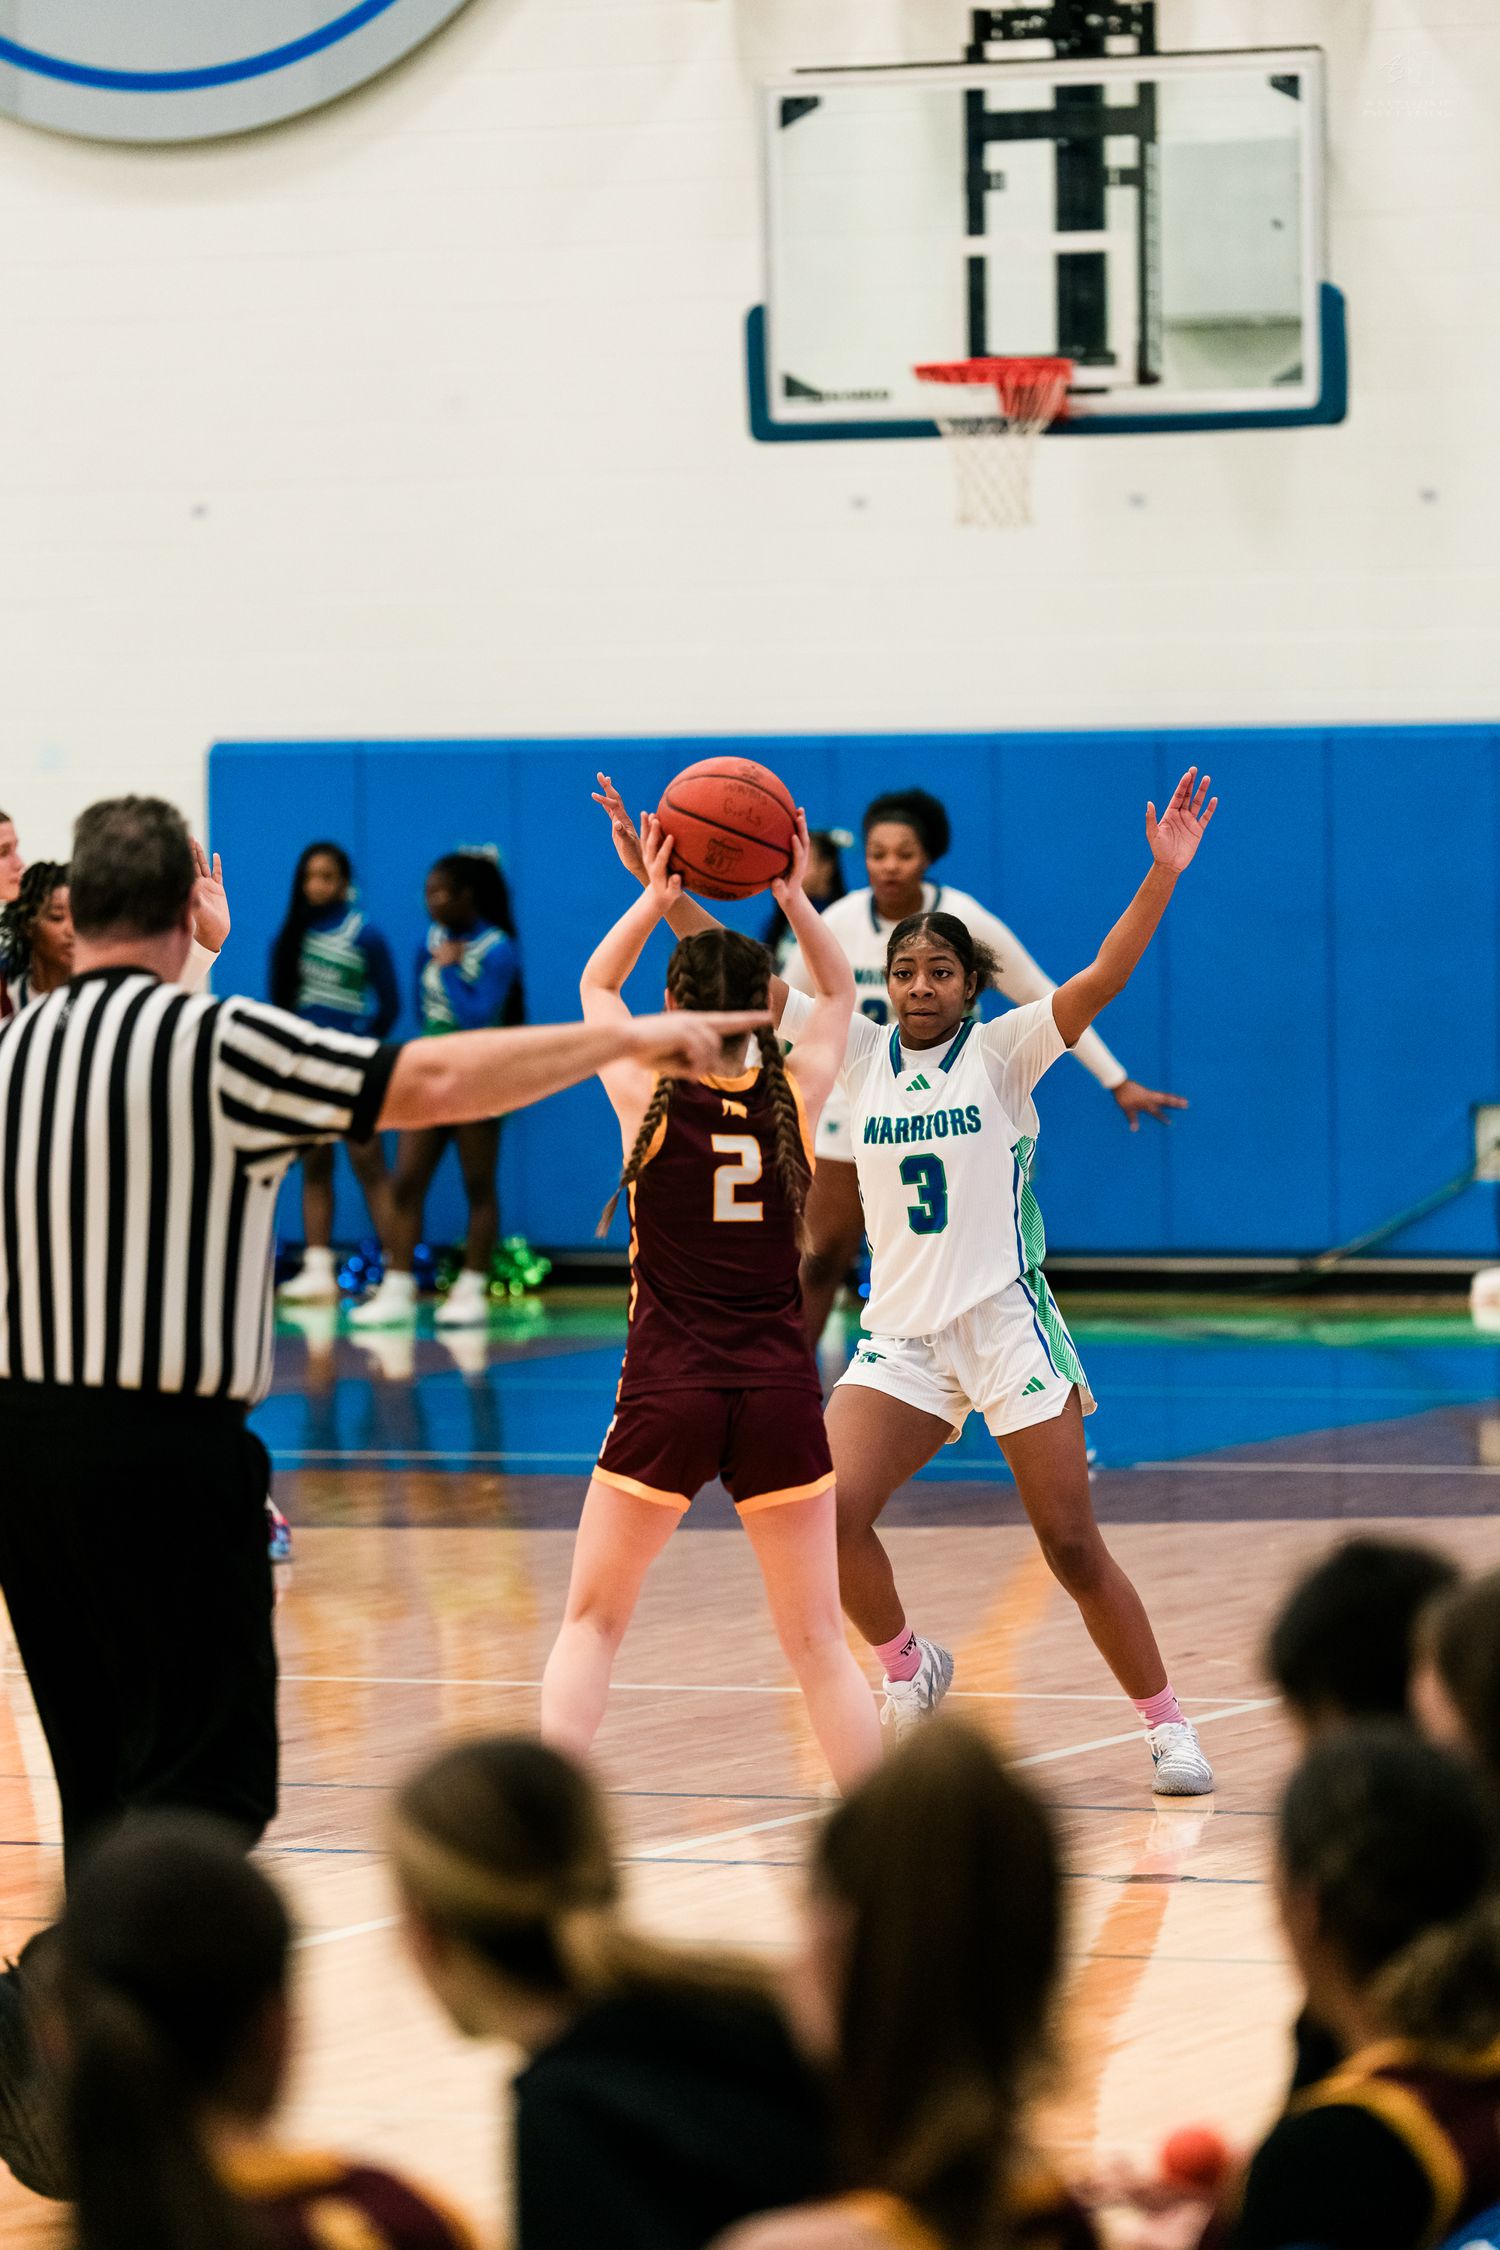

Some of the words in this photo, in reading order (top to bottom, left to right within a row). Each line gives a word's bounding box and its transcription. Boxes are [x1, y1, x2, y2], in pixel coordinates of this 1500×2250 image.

[863, 1105, 982, 1144] WARRIORS
[711, 1133, 763, 1222] 2
[899, 1153, 948, 1235] 3
